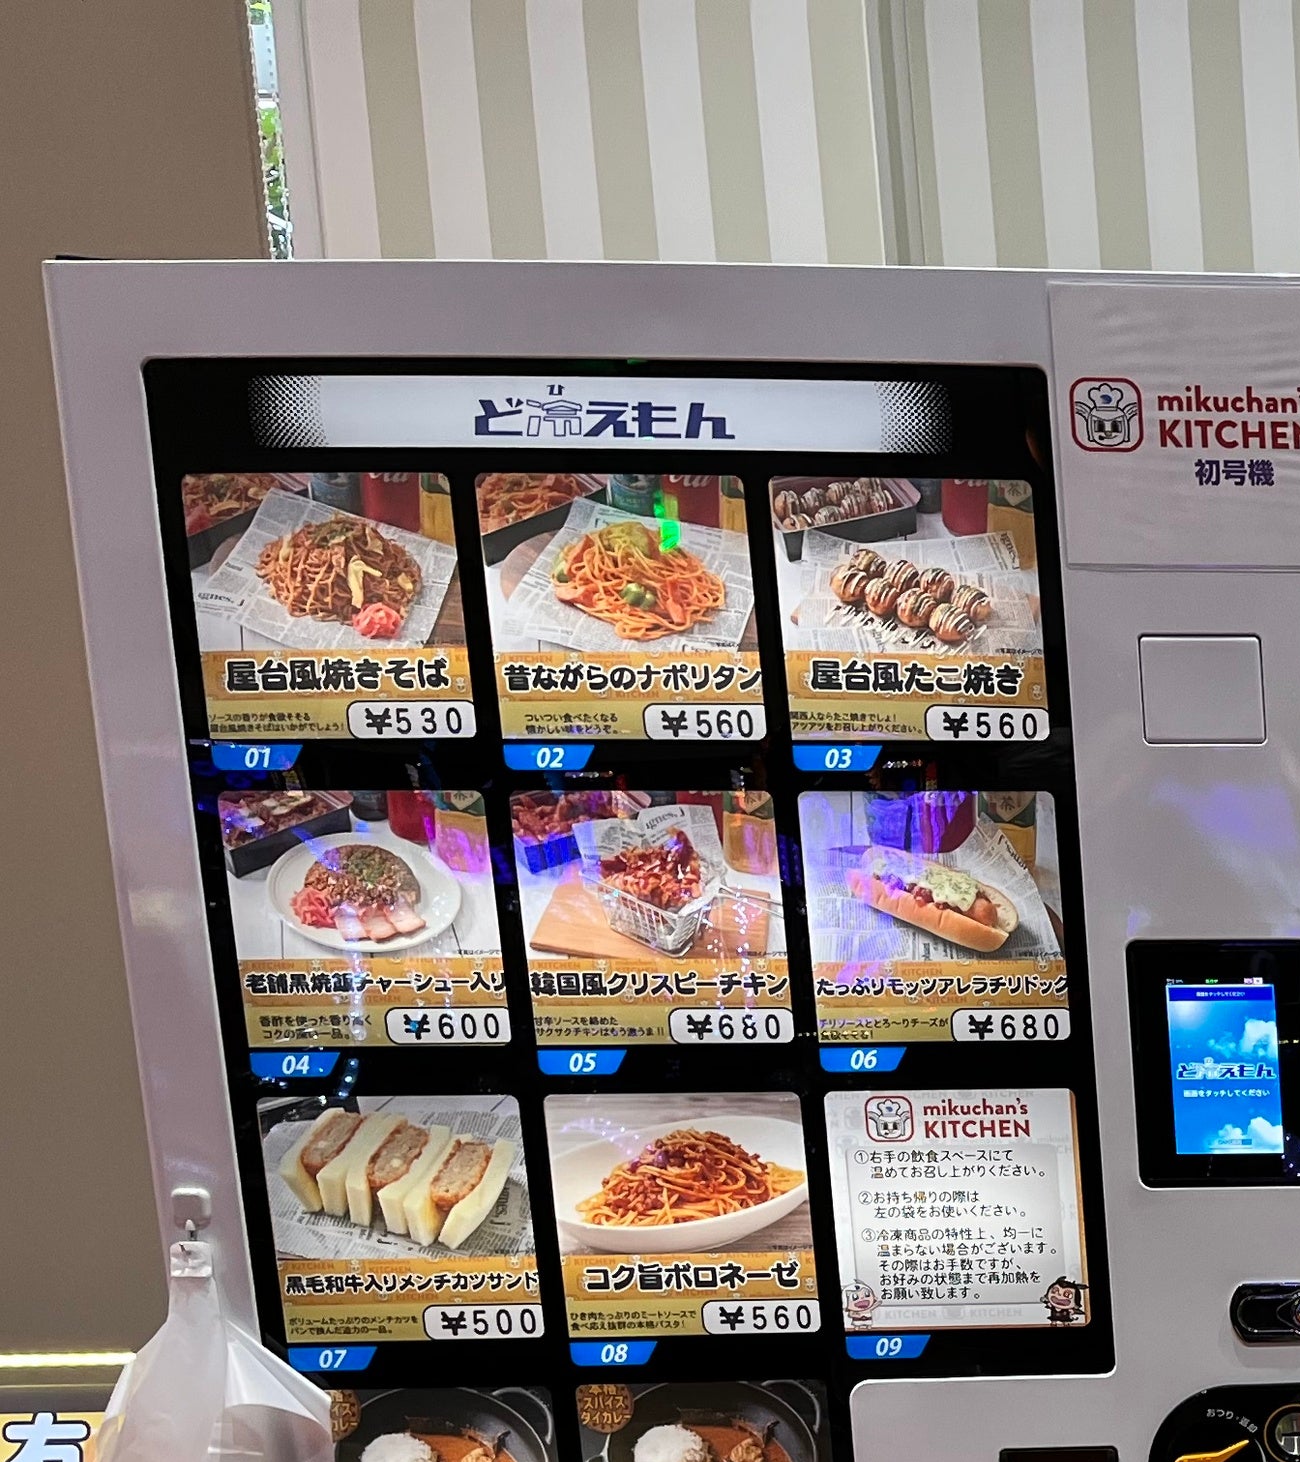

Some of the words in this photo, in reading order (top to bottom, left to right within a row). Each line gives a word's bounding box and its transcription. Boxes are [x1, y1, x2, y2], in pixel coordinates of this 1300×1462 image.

[1195, 459, 1274, 486] 初号機
[226, 659, 450, 691] 屋台風焼きそば
[504, 664, 761, 692] 昔ながらのナポリタン
[811, 662, 1022, 695] 屋台風たこ焼き
[366, 708, 462, 734] ¥530
[661, 709, 754, 738] ¥560
[944, 711, 1038, 739] ¥560
[245, 747, 270, 768] 01
[536, 748, 564, 768] 02
[824, 749, 852, 769] 03
[530, 972, 788, 996] 韓国風クリスピーチキン
[688, 1014, 781, 1039] ¥680
[969, 1014, 1060, 1041] ¥680
[282, 1055, 310, 1074] 04
[569, 1053, 596, 1072] 05
[850, 1049, 877, 1069] 06
[923, 1098, 1028, 1116] mikuchan's
[924, 1119, 1030, 1138] KITCHEN
[286, 1273, 538, 1296] 黒毛和牛入りメンチカツサンド
[585, 1263, 799, 1291] コク旨ボロネーゼ
[441, 1309, 536, 1336] ¥500
[719, 1305, 811, 1330] ¥560
[319, 1349, 346, 1369] 07
[601, 1344, 628, 1363] 08
[876, 1338, 902, 1356] 09
